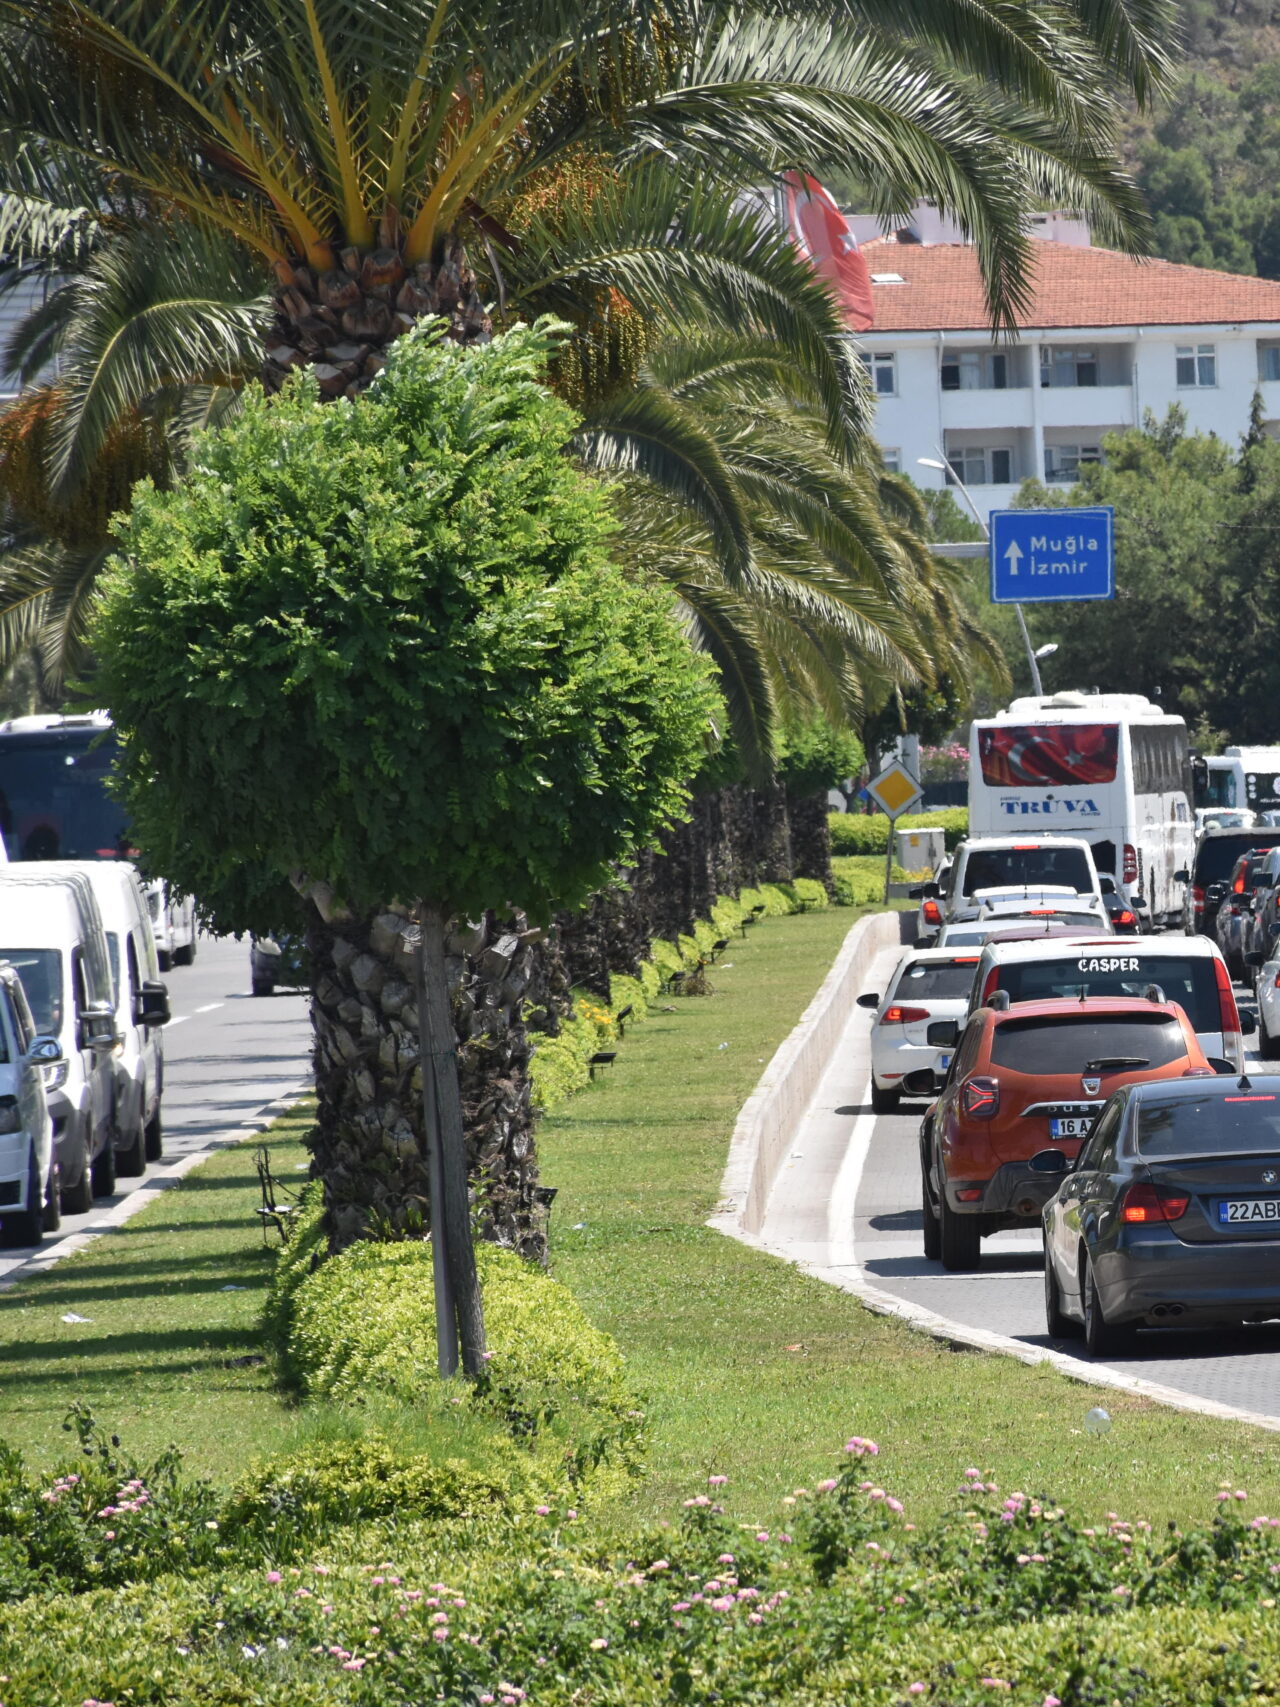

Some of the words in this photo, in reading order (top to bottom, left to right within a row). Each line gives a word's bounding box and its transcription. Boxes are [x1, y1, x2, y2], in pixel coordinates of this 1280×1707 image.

[1030, 535, 1098, 555] Muğla
[1031, 556, 1089, 575] İzmir
[1000, 798, 1099, 815] TRUVA
[1078, 957, 1140, 972] CASPER
[1048, 1103, 1105, 1113] DUST
[1060, 1120, 1075, 1134] 16
